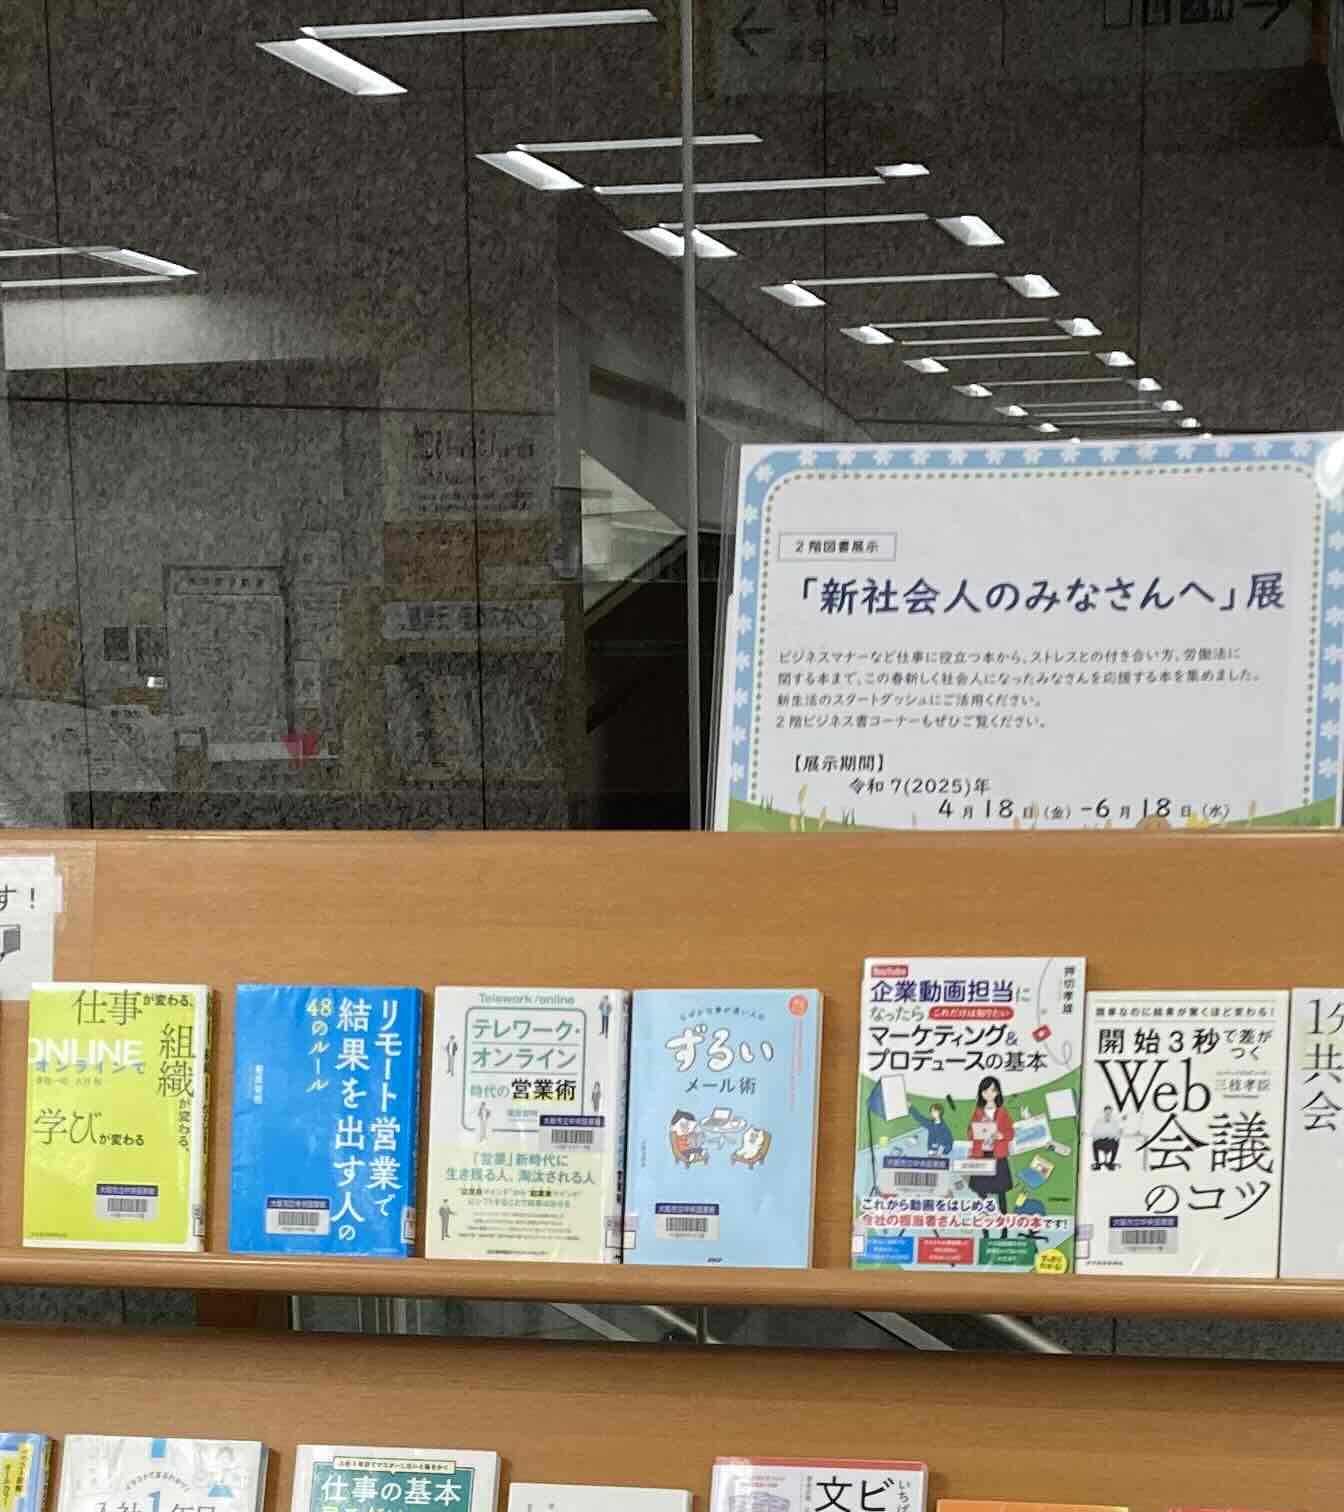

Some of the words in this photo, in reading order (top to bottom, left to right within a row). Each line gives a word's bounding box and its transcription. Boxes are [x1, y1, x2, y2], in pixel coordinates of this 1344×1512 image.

[799, 571, 1286, 616] 「新社会人のみなさんへ」展
[790, 754, 888, 773] 【展示期間】
[870, 979, 1032, 1004] 企業動画担当に
[869, 1006, 925, 1022] なったら
[305, 997, 334, 1093] 48のルール
[663, 1023, 775, 1072] ずるい
[869, 1023, 1018, 1048] マーケティング&
[1097, 1028, 1221, 1055] 開始3秒
[29, 1039, 144, 1065] ONLINE
[471, 1048, 578, 1070] オンライン
[867, 1049, 1048, 1072] プロデュースの基本
[469, 1078, 577, 1101] 時代の営業術
[684, 1076, 757, 1095] メール術
[1094, 1057, 1211, 1113] Web
[330, 997, 372, 1241] 結果を出す人の
[367, 999, 403, 1217] リモート営業で
[33, 1108, 145, 1146] 学びが変わる
[1135, 1112, 1274, 1174] 会議
[1144, 1180, 1271, 1221] のコツ
[319, 1473, 463, 1506] 仕事の基本
